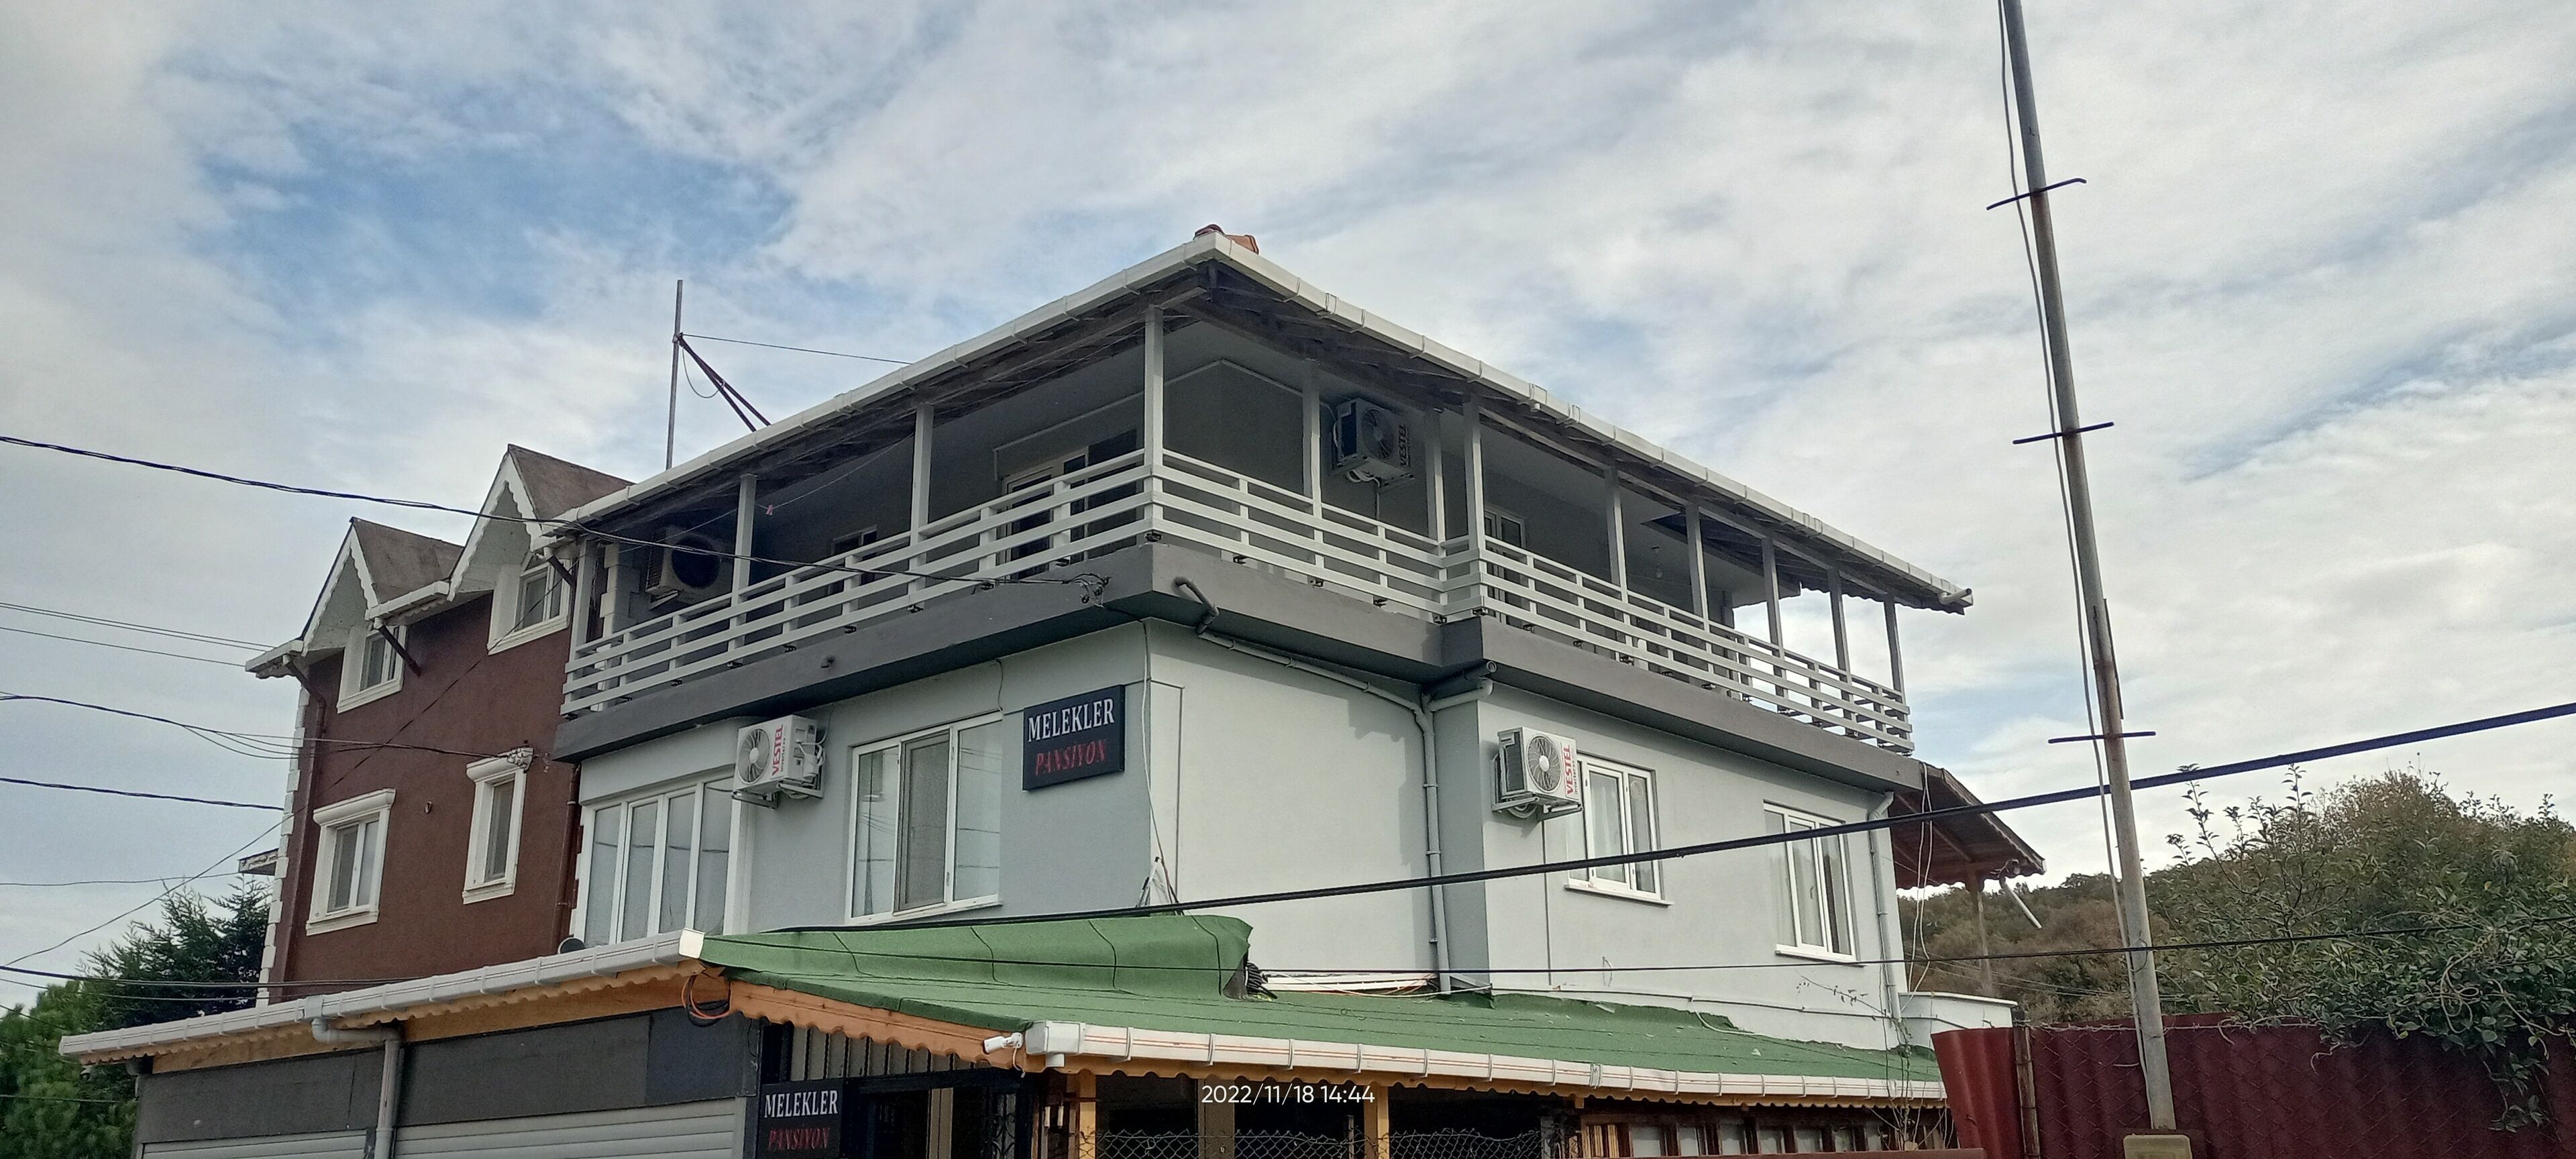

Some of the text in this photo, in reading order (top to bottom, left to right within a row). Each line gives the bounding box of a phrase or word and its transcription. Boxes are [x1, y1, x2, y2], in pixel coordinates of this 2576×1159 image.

[1398, 425, 1407, 466] VESTEL
[1028, 698, 1114, 742] MELEKLER
[772, 724, 784, 776] VESTEL
[1563, 745, 1574, 795] VESTEL
[764, 1090, 838, 1118] MELEKLER
